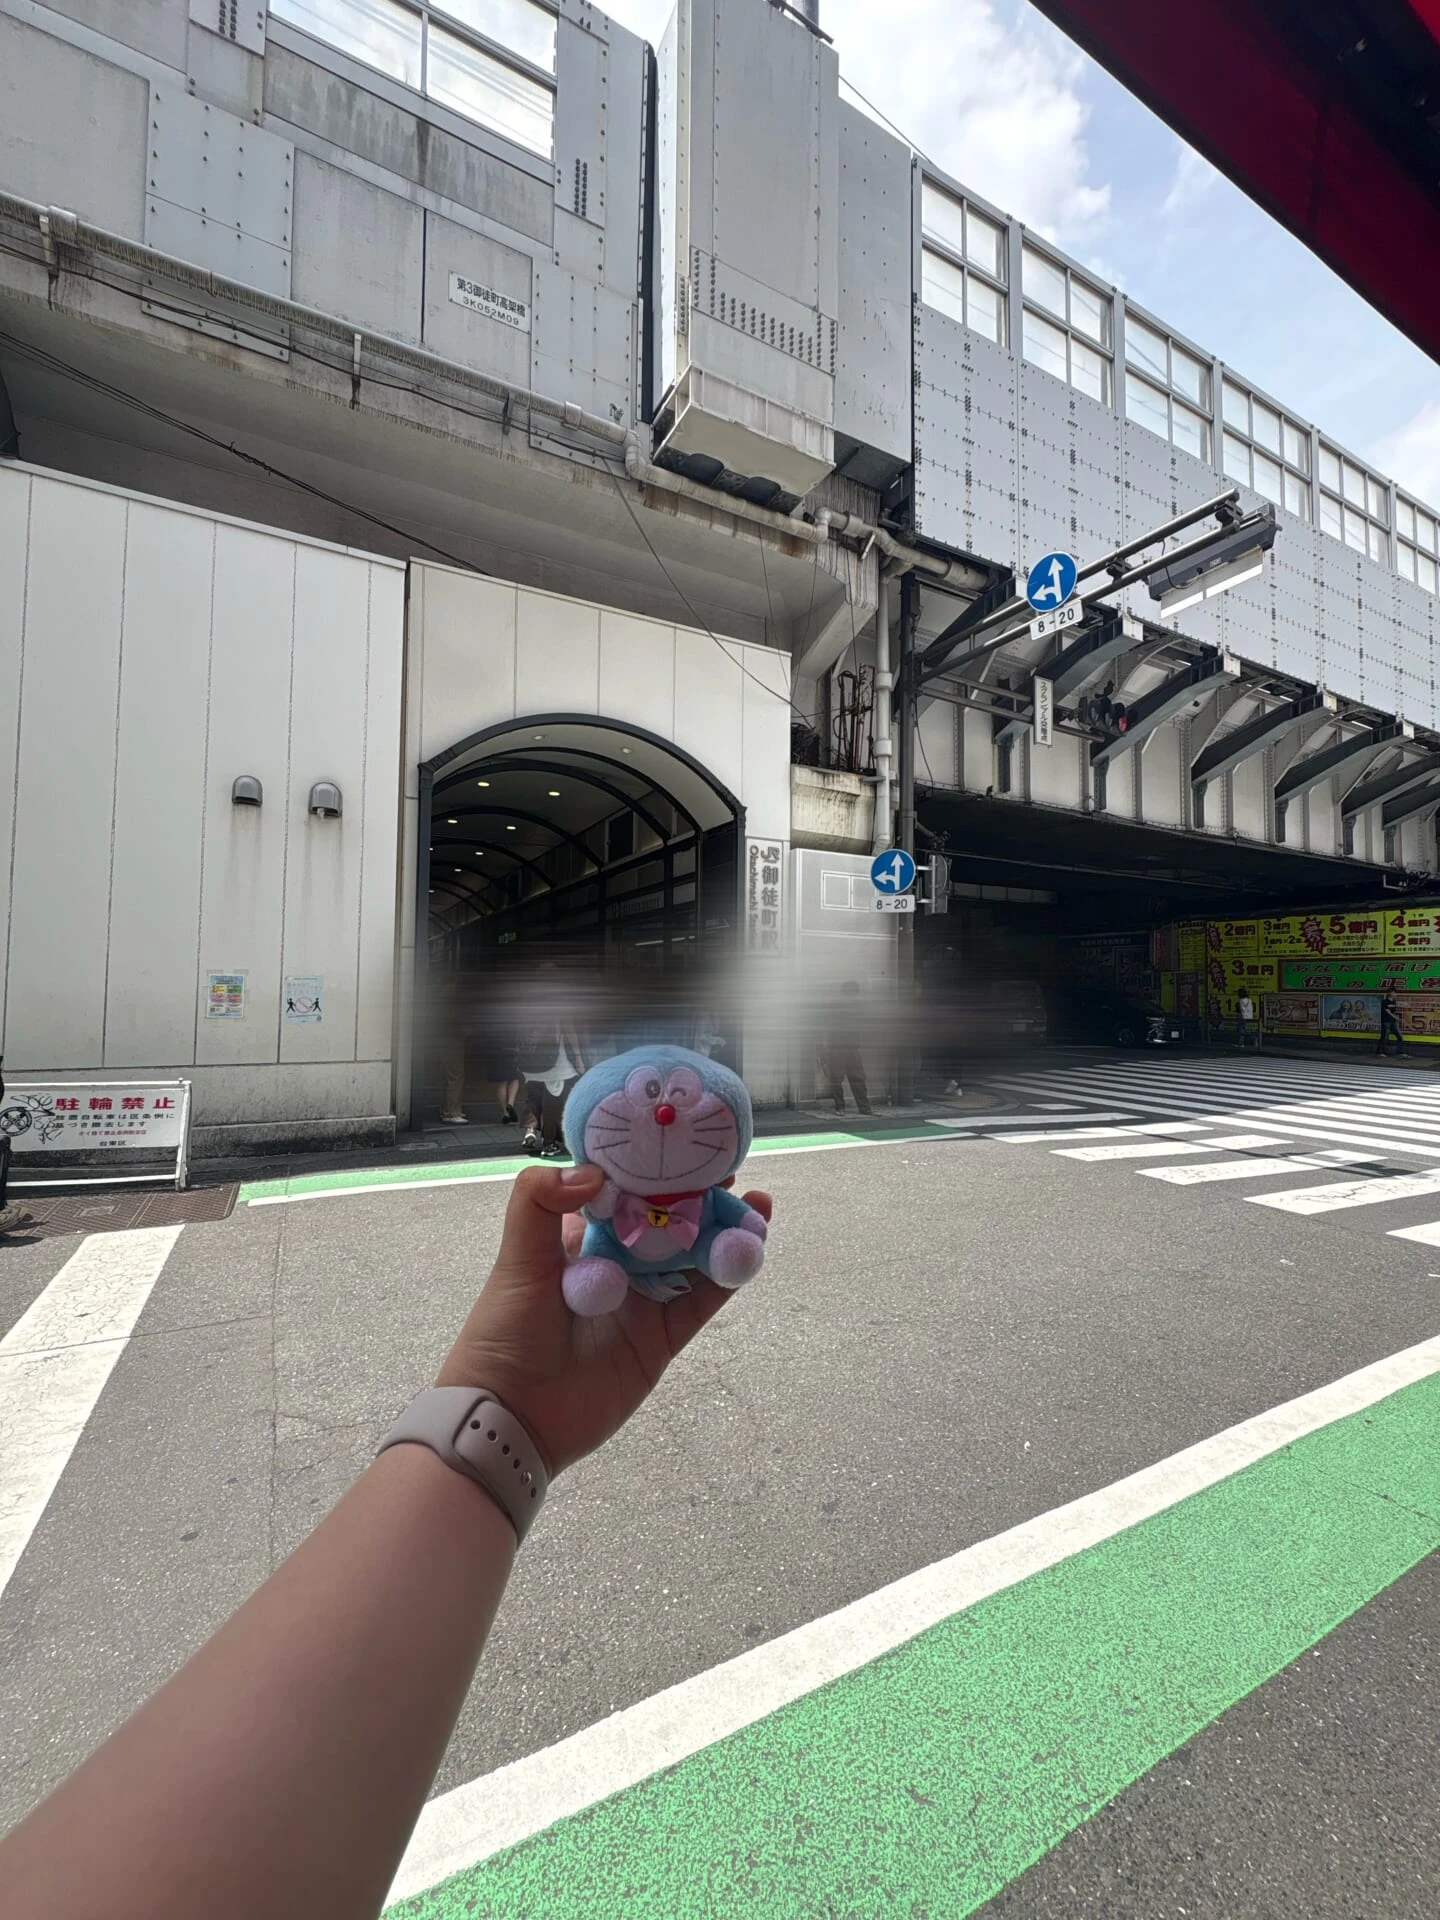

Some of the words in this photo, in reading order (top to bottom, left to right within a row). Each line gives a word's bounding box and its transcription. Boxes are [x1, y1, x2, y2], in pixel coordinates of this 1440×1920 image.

[456, 277, 526, 318] 第3御徒町高架橋
[463, 296, 520, 326] 3K052M09
[54, 1096, 176, 1111] 駐輪禁止
